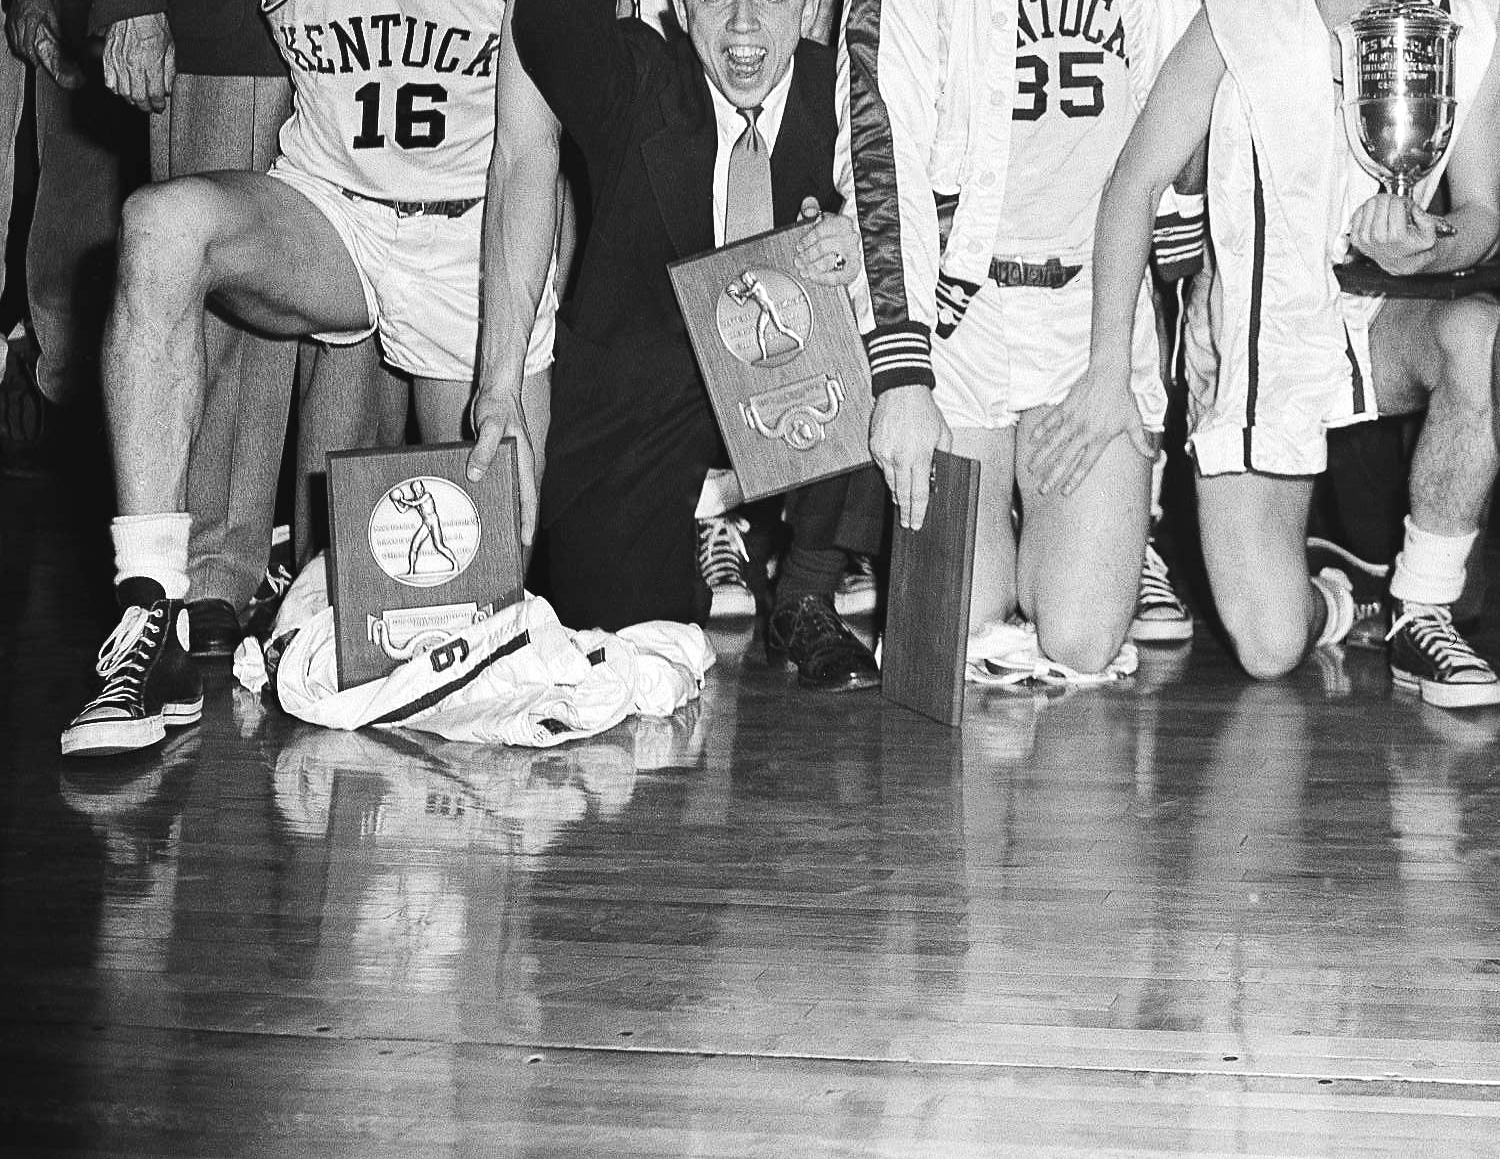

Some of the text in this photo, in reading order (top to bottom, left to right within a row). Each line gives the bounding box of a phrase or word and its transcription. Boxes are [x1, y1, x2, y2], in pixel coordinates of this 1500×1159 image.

[279, 13, 500, 77] KENTUCK
[352, 82, 447, 149] 16
[1012, 51, 1104, 121] 35
